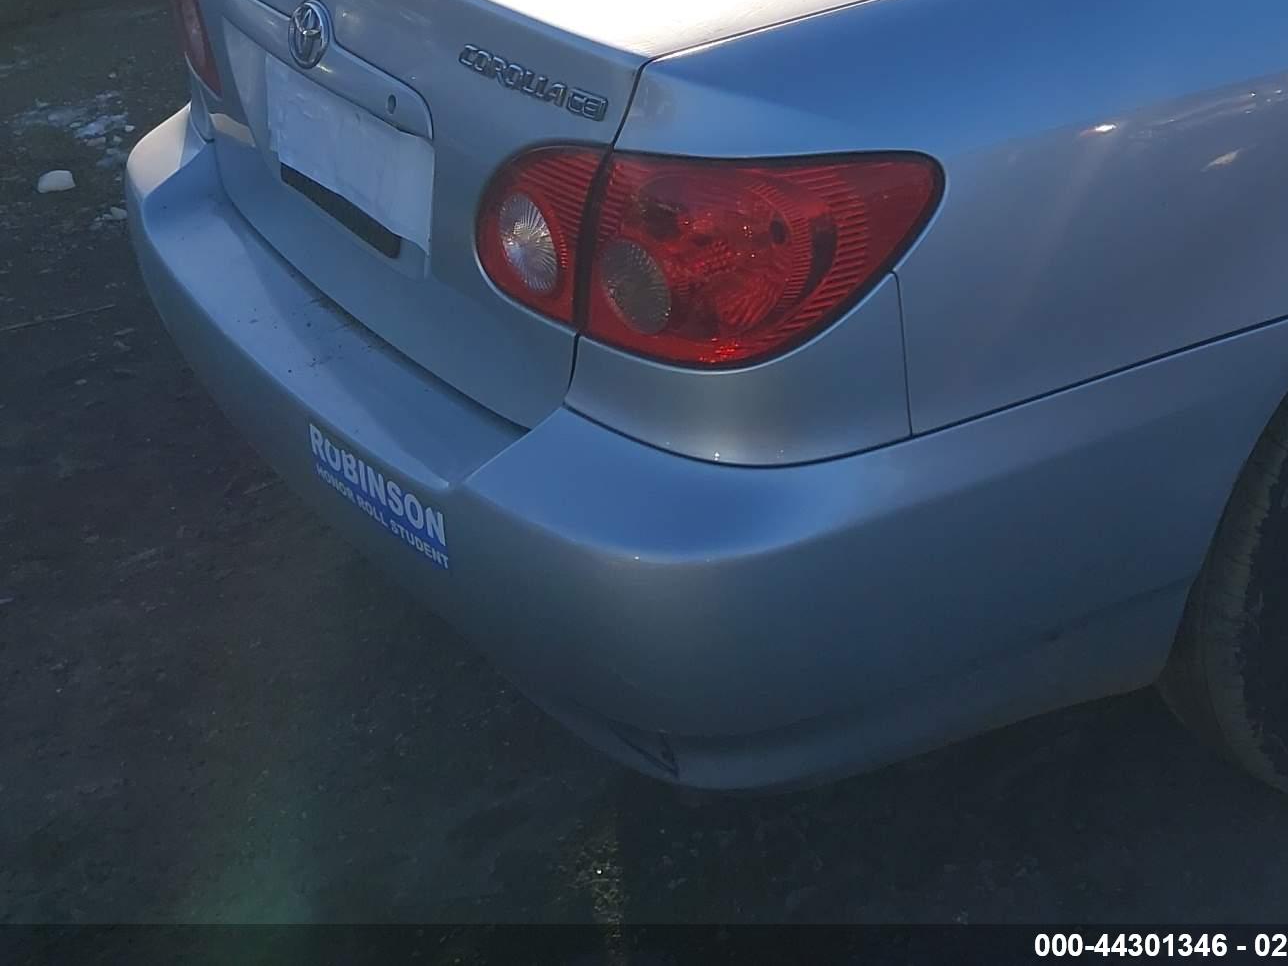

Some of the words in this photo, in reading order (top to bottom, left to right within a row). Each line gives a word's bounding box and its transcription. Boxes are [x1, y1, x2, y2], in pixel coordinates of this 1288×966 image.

[458, 43, 568, 107] COROLLA
[309, 423, 446, 546] ROBINSON
[390, 520, 449, 569] STUDENT
